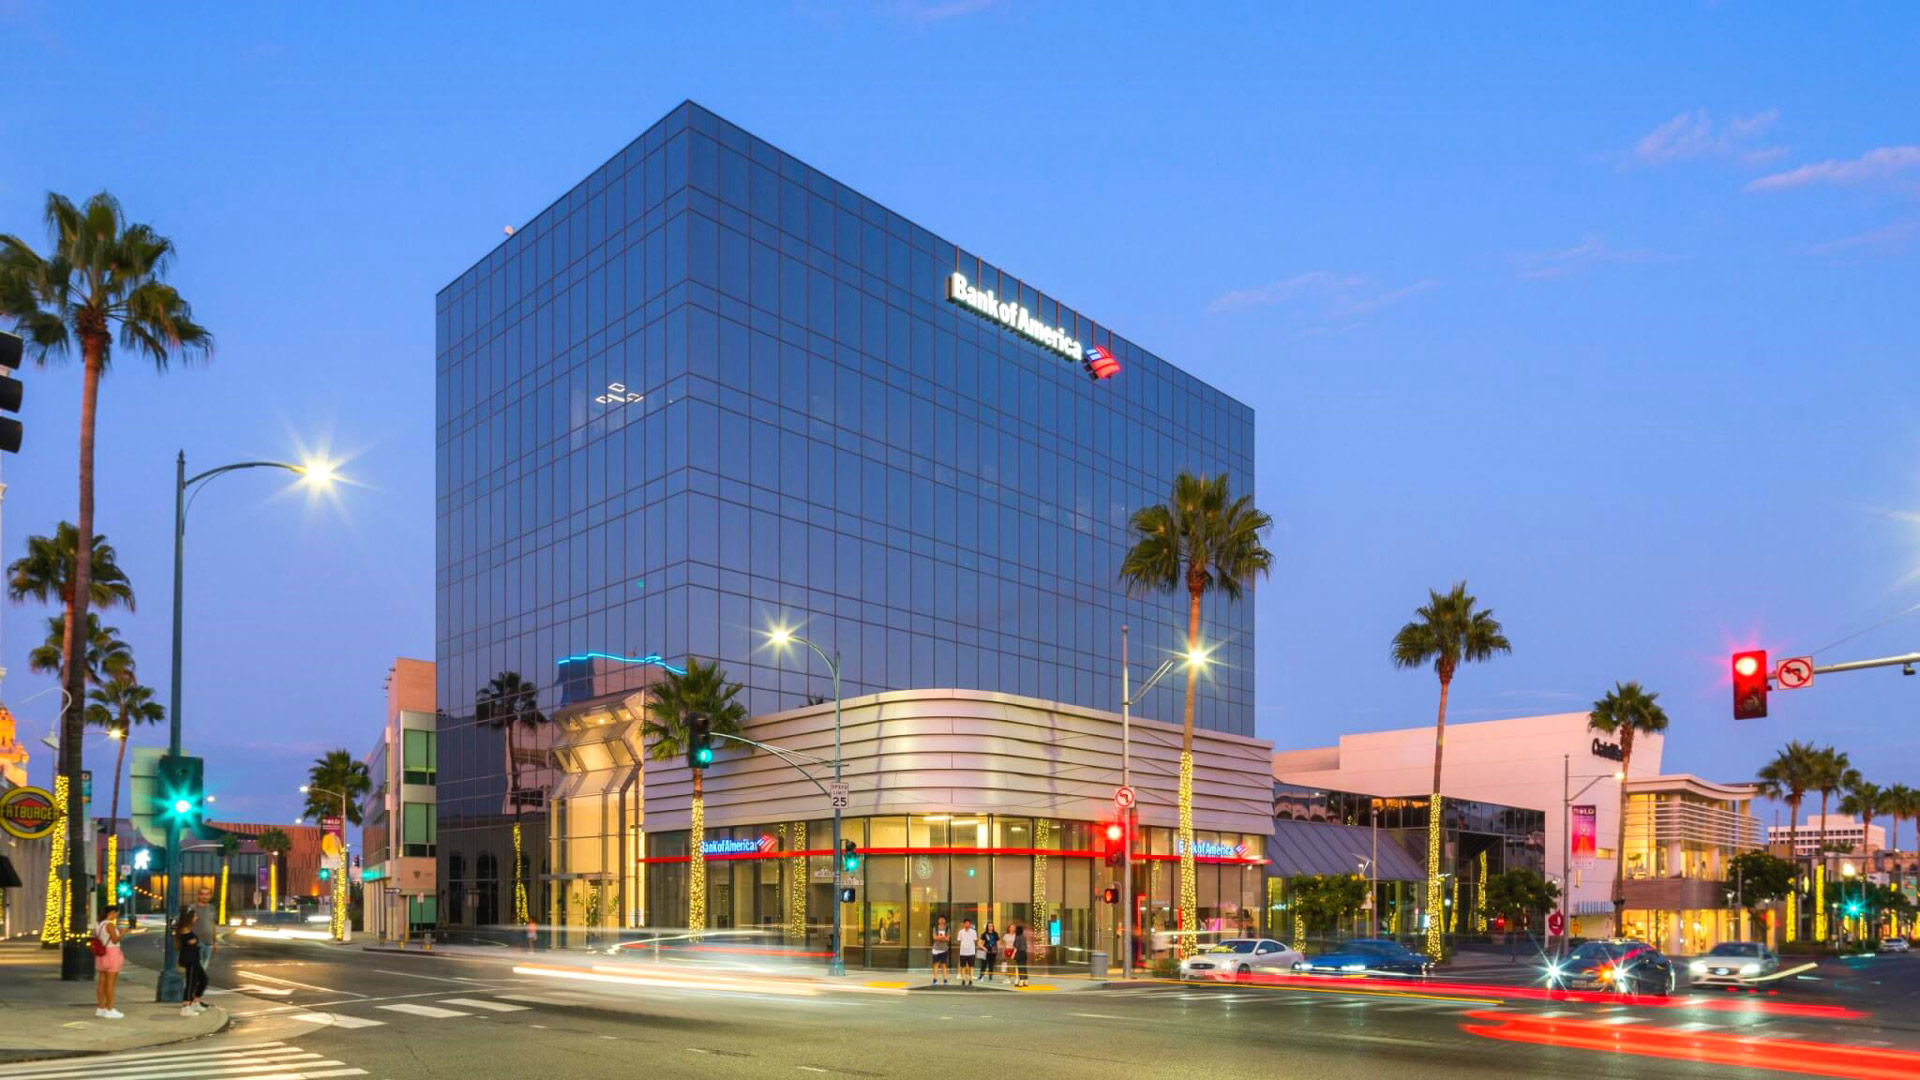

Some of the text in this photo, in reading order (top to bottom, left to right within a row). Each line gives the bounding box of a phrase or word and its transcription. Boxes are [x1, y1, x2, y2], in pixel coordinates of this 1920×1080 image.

[951, 271, 1082, 361] Bank of America
[832, 796, 847, 807] 25
[1, 804, 60, 820] FATBURGER
[1178, 839, 1198, 855] Bk
